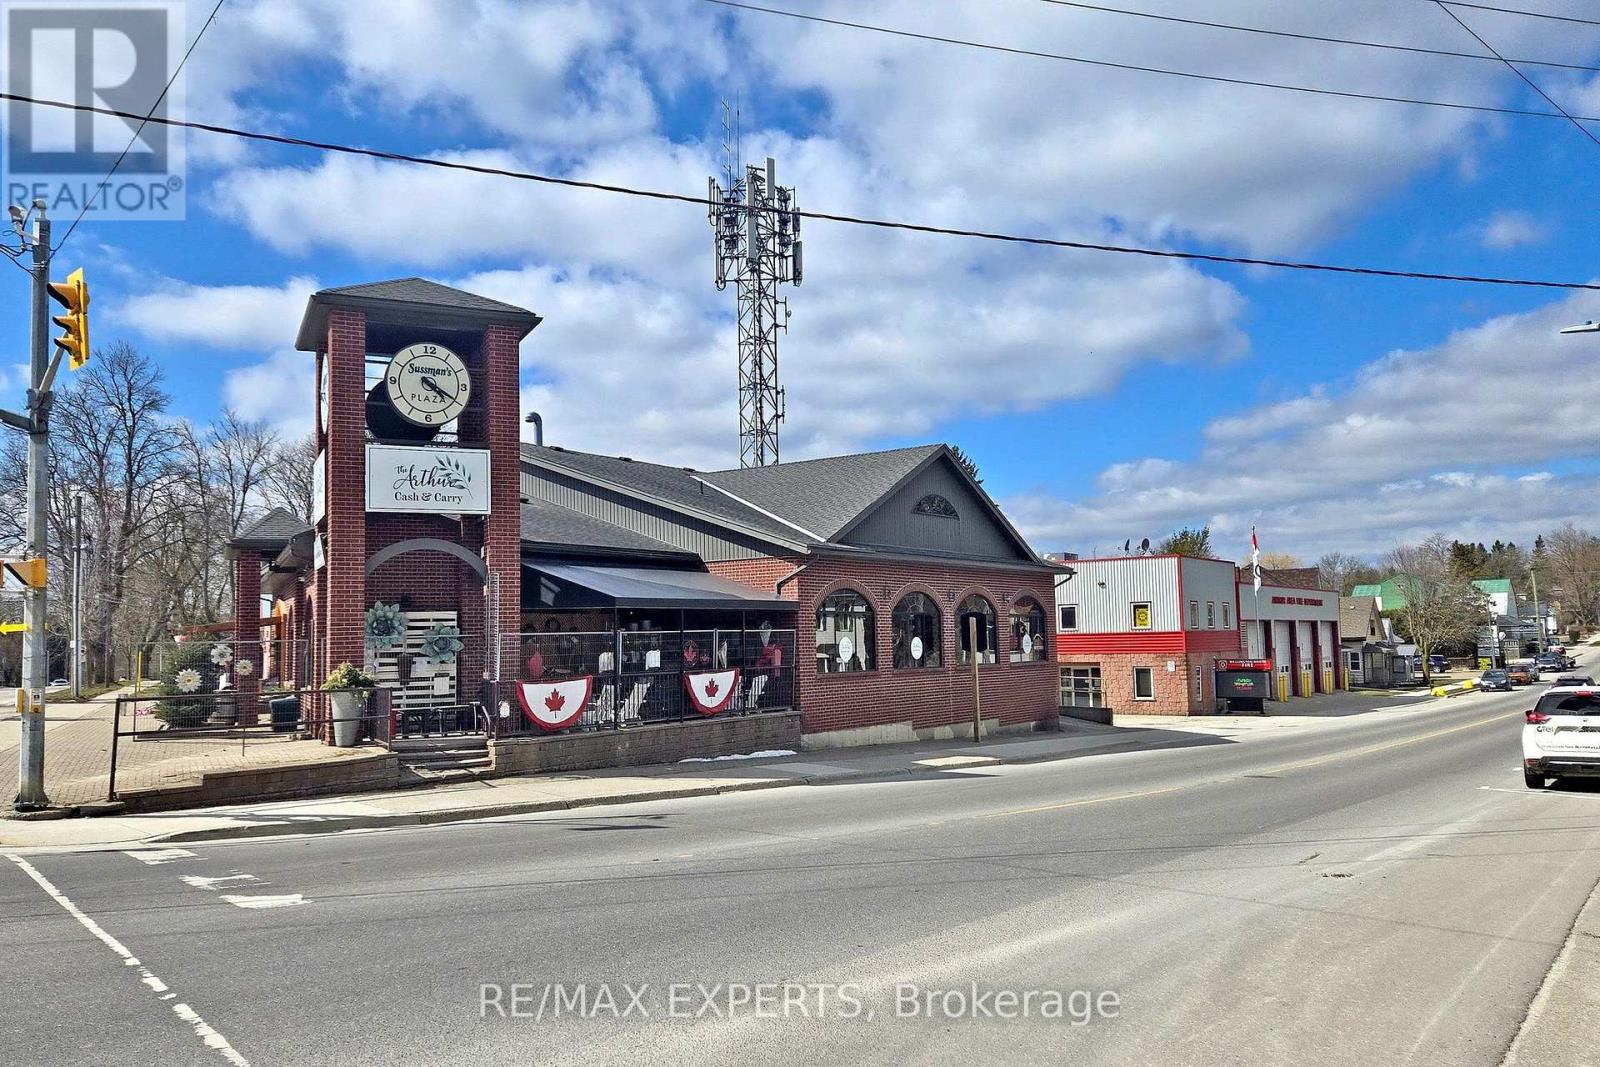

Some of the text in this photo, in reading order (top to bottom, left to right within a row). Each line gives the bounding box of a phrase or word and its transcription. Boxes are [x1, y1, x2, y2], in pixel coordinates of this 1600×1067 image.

[423, 345, 437, 355] 12
[408, 362, 453, 377] Sussman's
[389, 376, 397, 385] 9
[460, 383, 468, 392] 3
[411, 393, 447, 404] PLAZA
[424, 414, 432, 423] 6
[393, 464, 457, 490] Arthur
[394, 491, 463, 505] Cash & Carry
